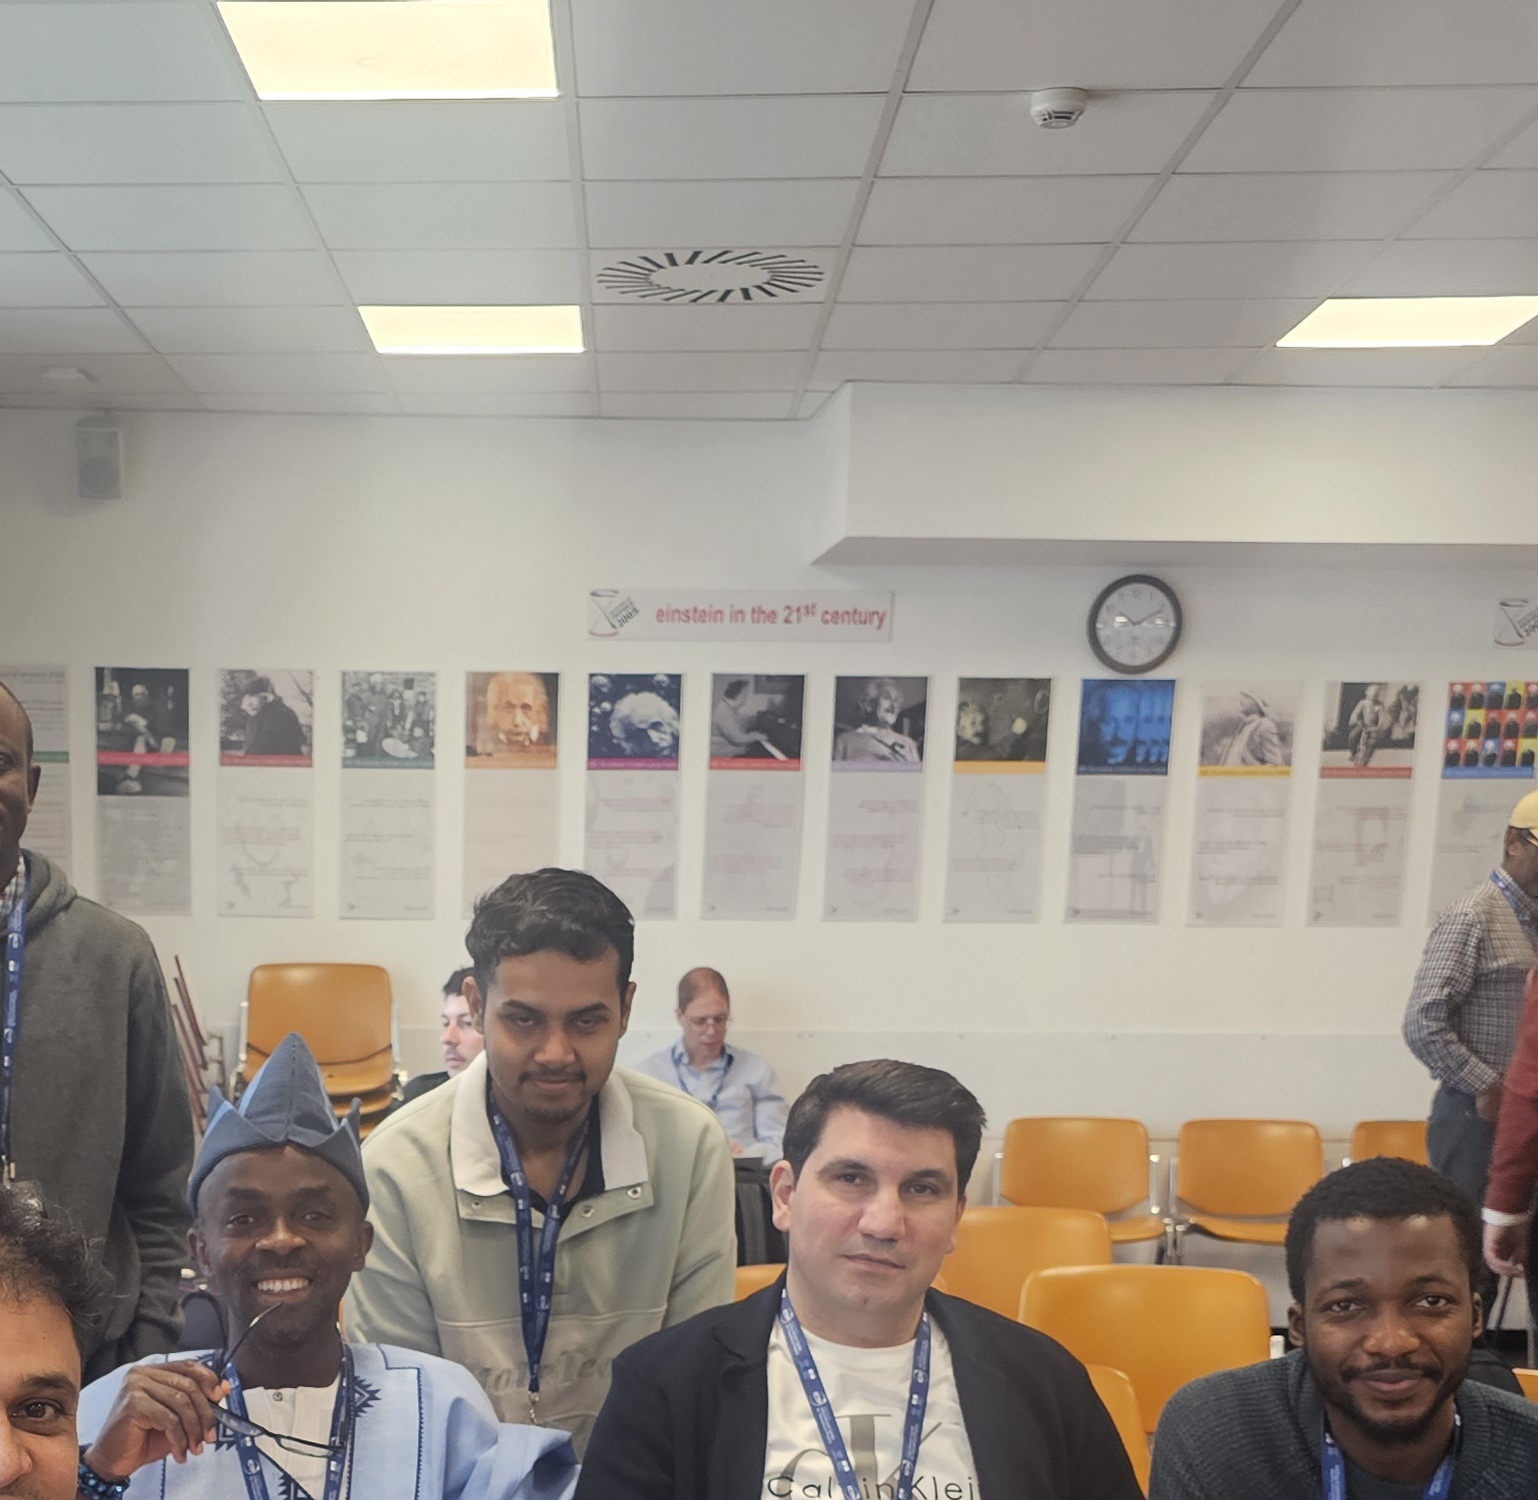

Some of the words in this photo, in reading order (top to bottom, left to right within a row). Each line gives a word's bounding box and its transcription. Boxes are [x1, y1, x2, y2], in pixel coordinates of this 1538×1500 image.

[655, 604, 725, 625] einstein
[729, 604, 746, 625] in
[750, 603, 778, 625] the
[782, 603, 817, 625] 21st
[820, 607, 888, 630] century
[768, 1475, 895, 1500] Calin
[912, 1475, 974, 1500] Klei
